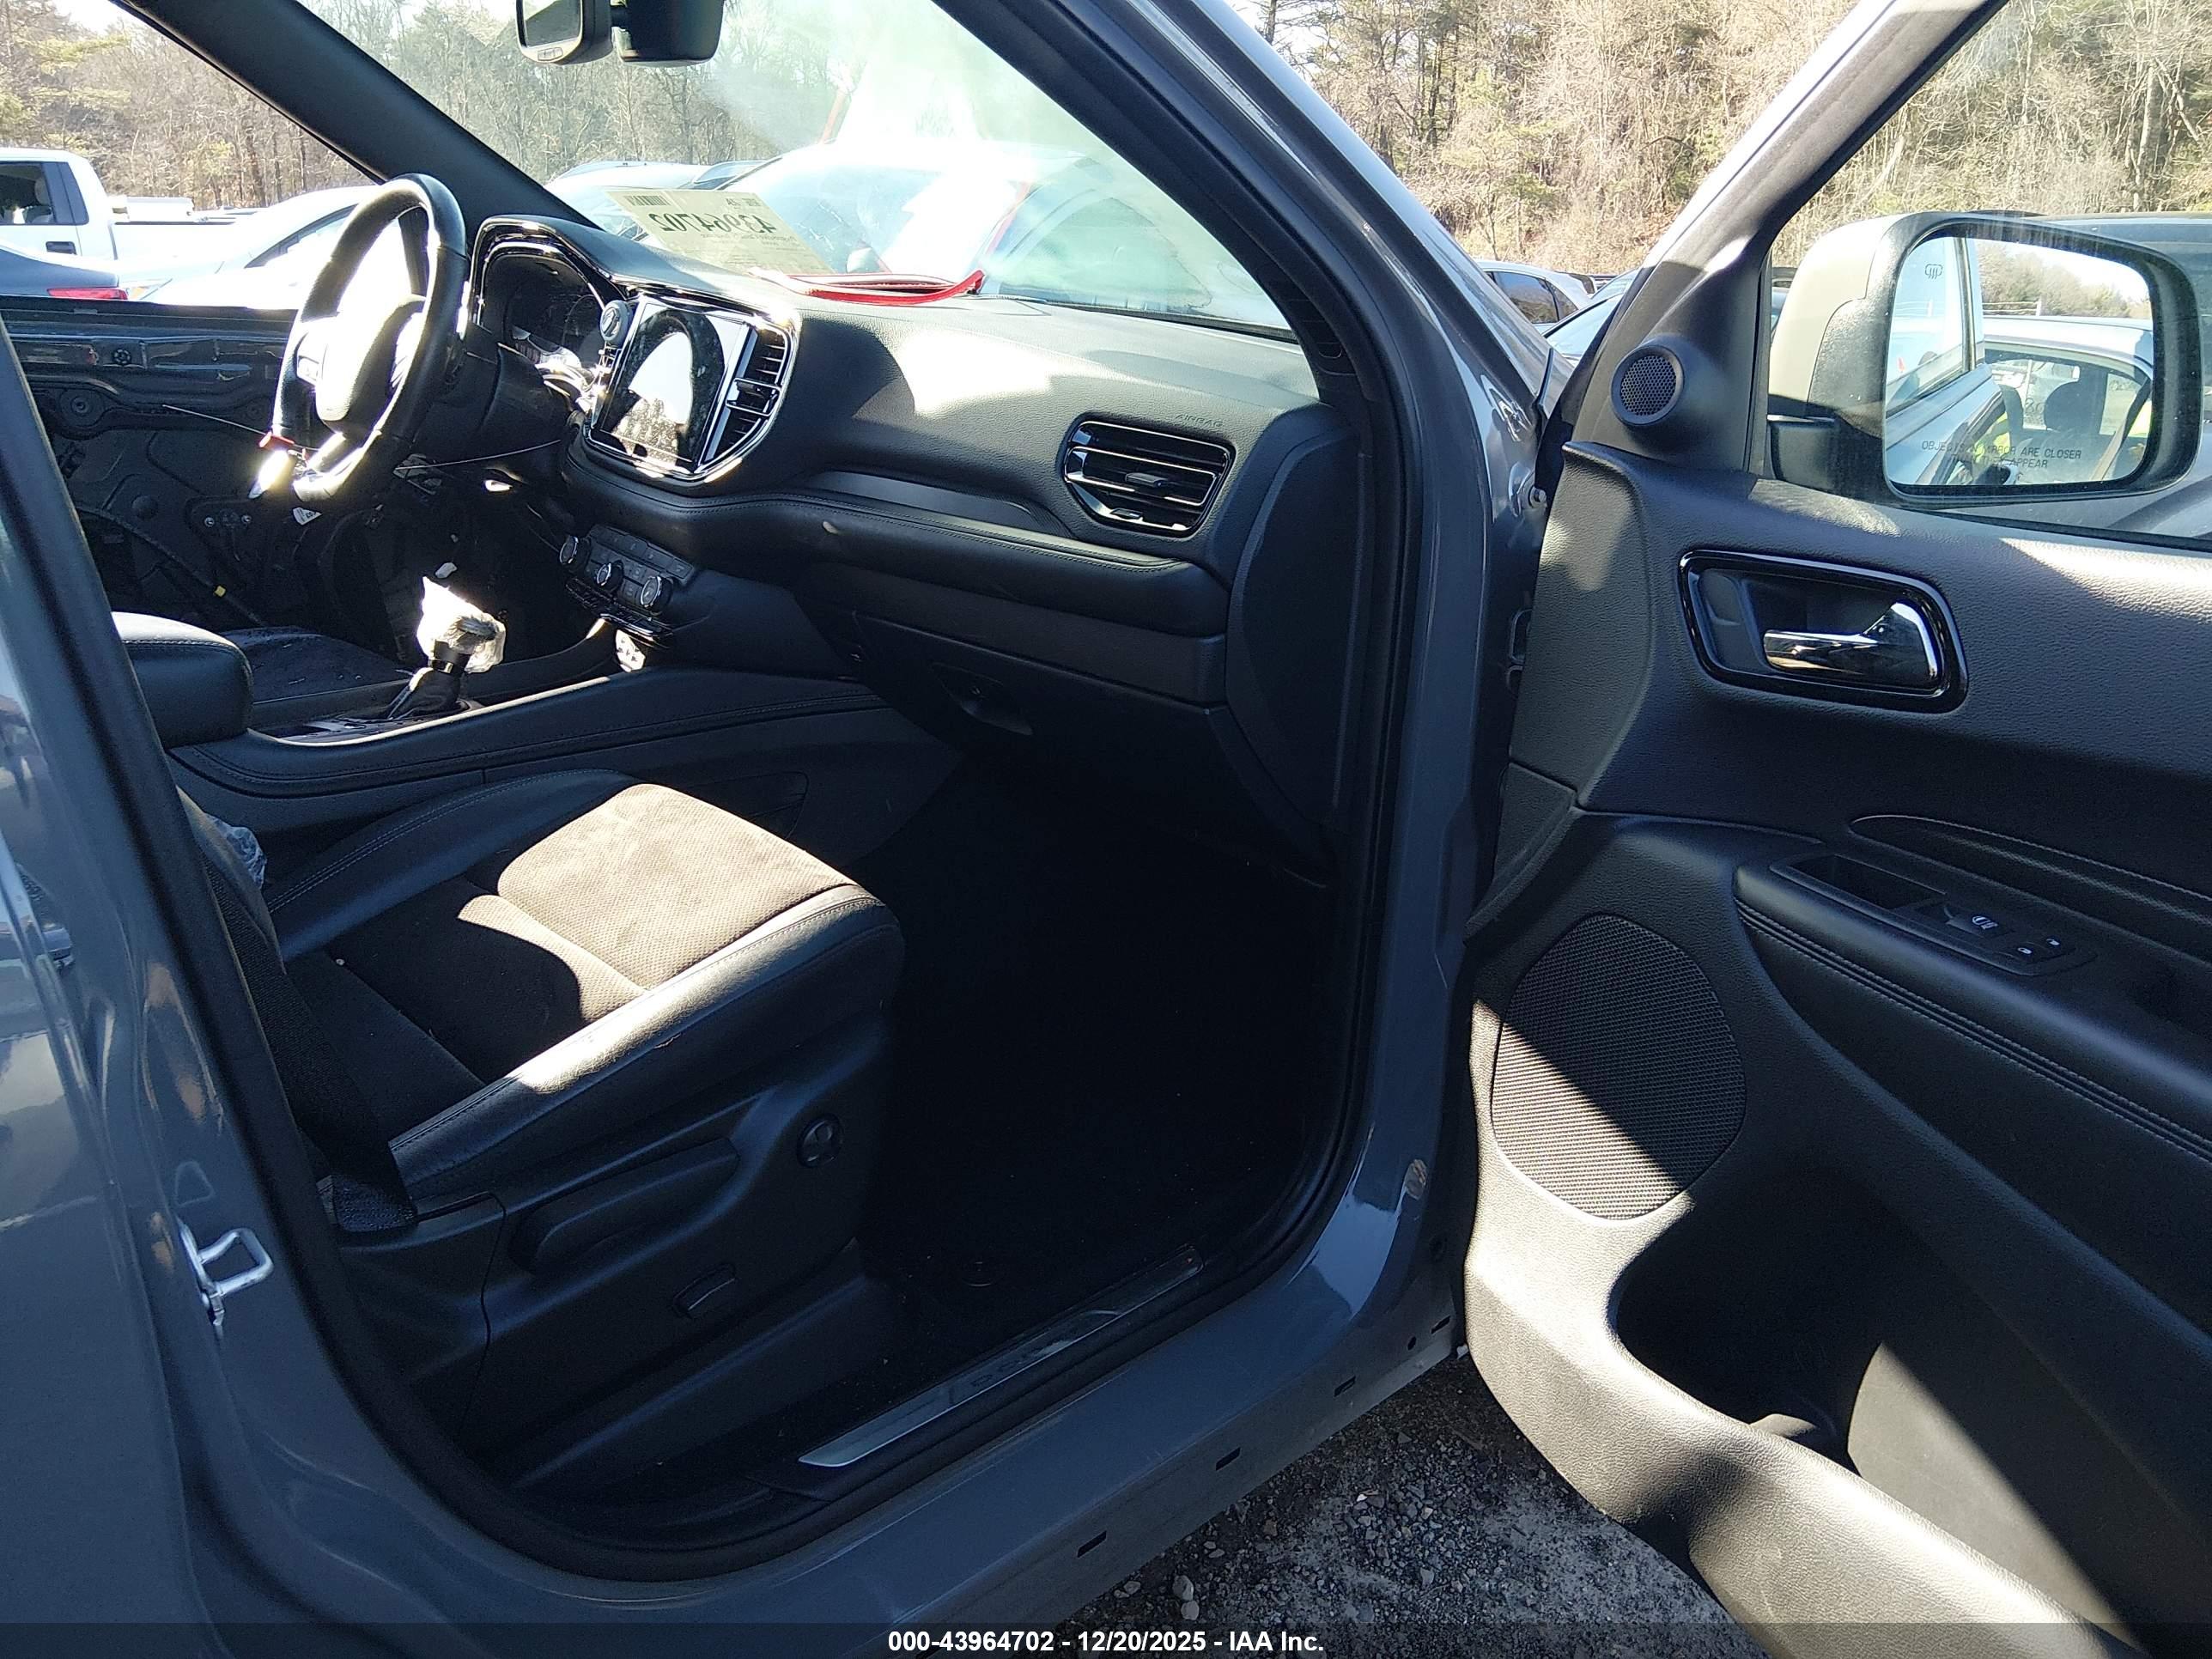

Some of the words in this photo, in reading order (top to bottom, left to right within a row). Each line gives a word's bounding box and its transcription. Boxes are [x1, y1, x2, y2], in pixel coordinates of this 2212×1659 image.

[1175, 414, 1224, 428] AIRBAG
[2021, 447, 2041, 457] ARE
[2044, 448, 2081, 459] CLOSER
